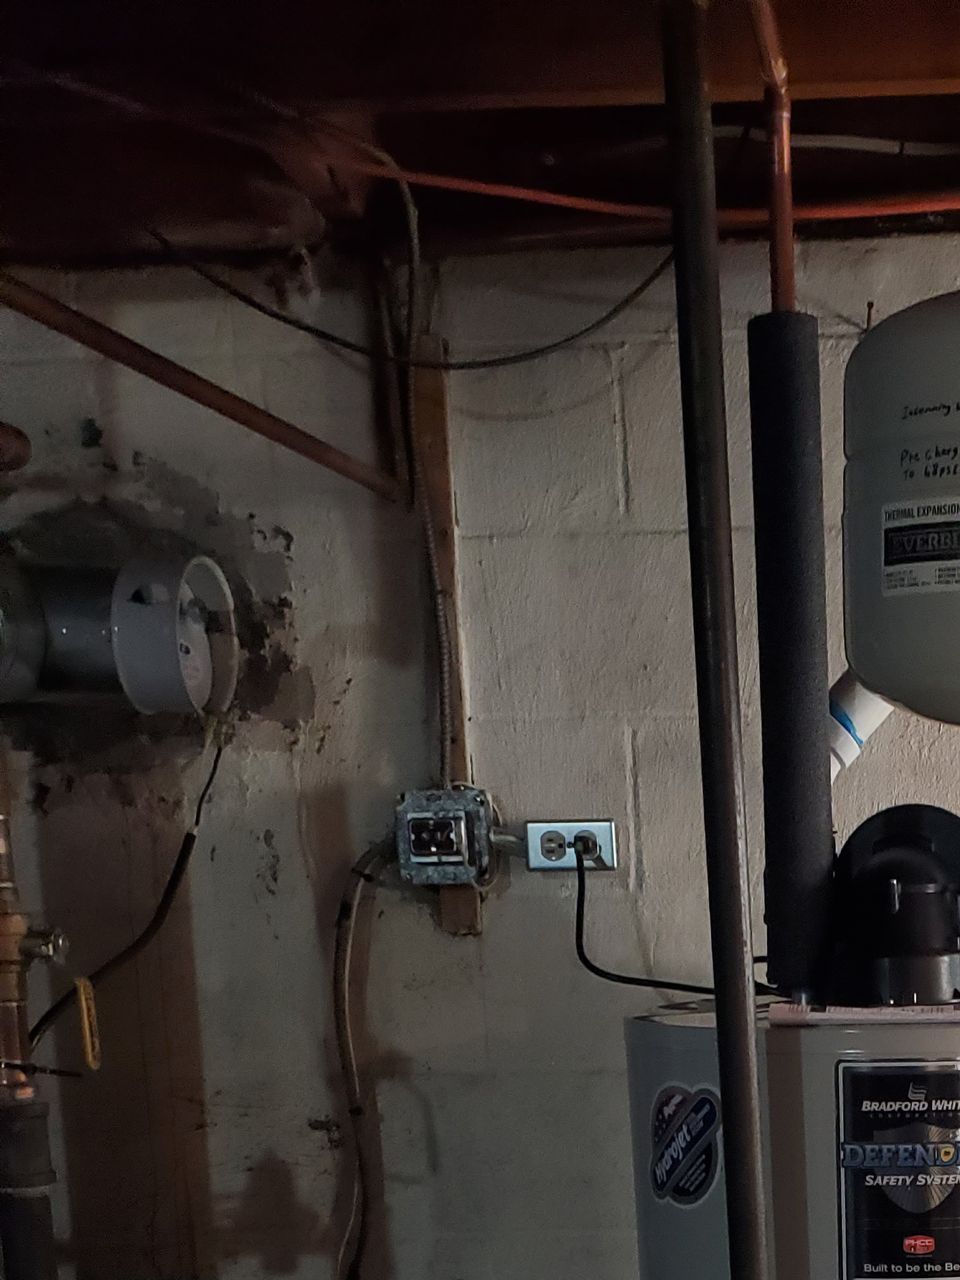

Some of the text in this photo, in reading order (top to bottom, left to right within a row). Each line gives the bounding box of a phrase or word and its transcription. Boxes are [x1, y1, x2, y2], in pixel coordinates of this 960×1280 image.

[884, 507, 915, 522] THERMAL
[861, 1100, 928, 1111] BRADFORD
[865, 1174, 914, 1186] SAFETY
[864, 1263, 888, 1273] Built
[891, 1264, 902, 1273] to
[906, 1264, 920, 1272] be
[924, 1263, 941, 1272] the
